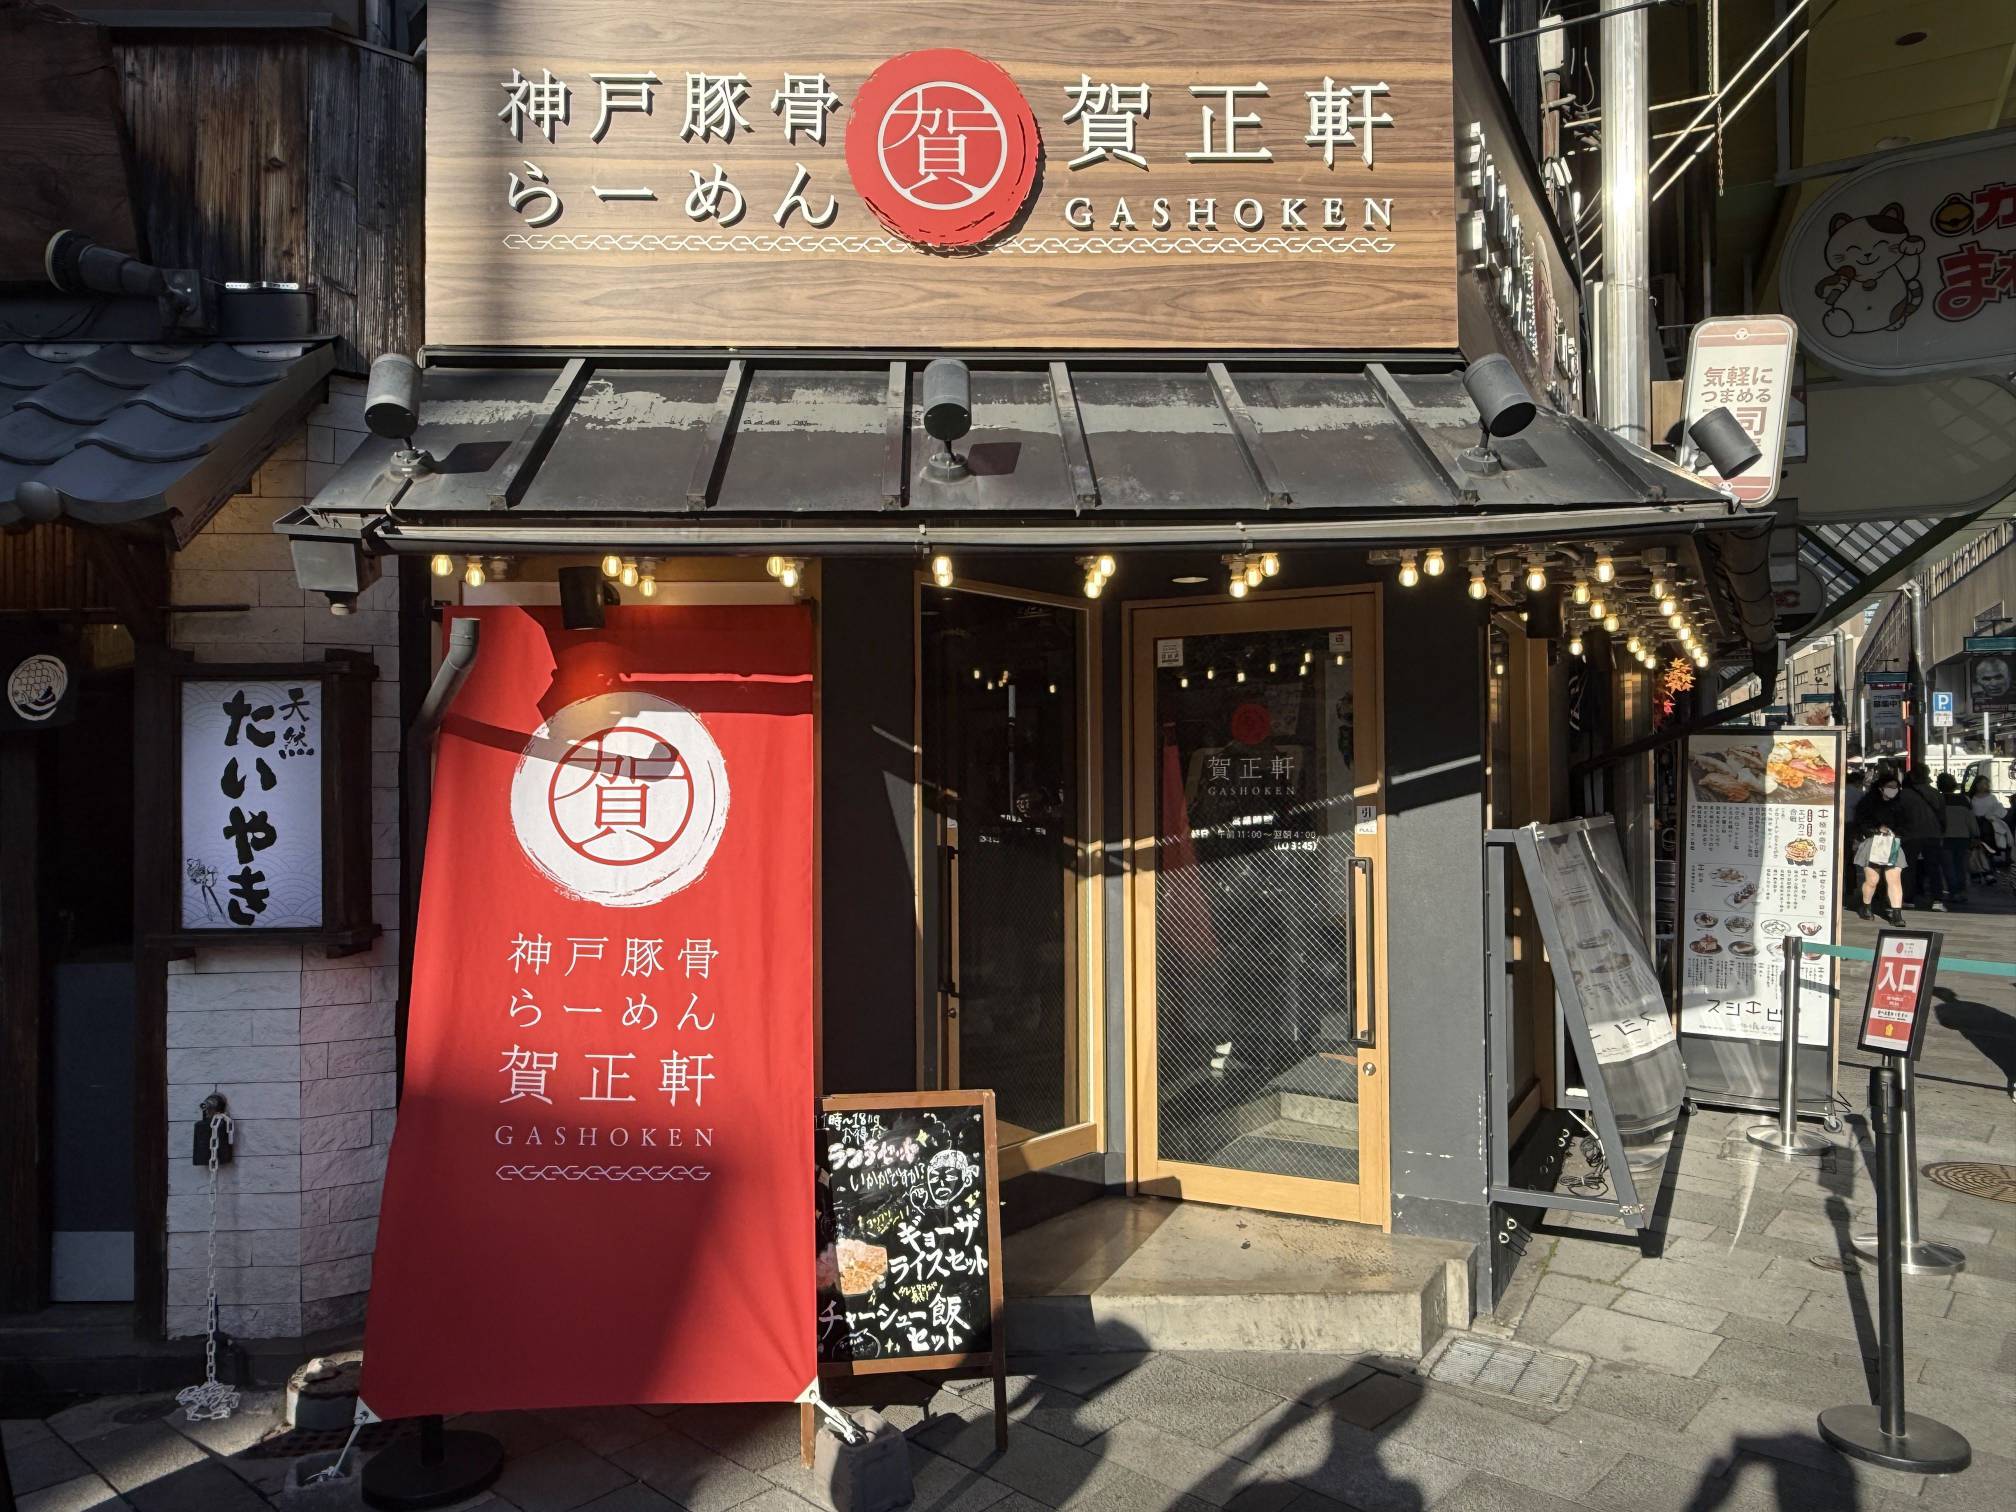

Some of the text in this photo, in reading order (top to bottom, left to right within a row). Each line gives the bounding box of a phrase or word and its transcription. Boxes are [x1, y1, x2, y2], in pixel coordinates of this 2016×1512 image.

[498, 68, 841, 143] 神戸豚骨
[1062, 73, 1395, 169] 賀正軒
[508, 161, 838, 226] らーめん
[1064, 197, 1393, 230] GASHOKEN
[1701, 388, 1772, 403] つまめる
[1703, 366, 1773, 387] 気軽に
[1937, 695, 1949, 710] P
[279, 688, 314, 759] 天然
[1207, 756, 1296, 782] 賀正軒
[221, 689, 277, 926] たいやき
[1207, 786, 1297, 796] GASHOKEN
[507, 932, 720, 980] 神戸豚骨
[1878, 962, 1921, 994] 入口
[509, 993, 716, 1032] らーめん
[499, 1044, 716, 1108] 賀正軒
[494, 1124, 714, 1148] GASHOKEN
[898, 1208, 982, 1252] ギョーザ
[889, 1245, 988, 1284] ライスセット
[819, 1292, 971, 1340] チャーシュー飯
[907, 1326, 962, 1352] セット
